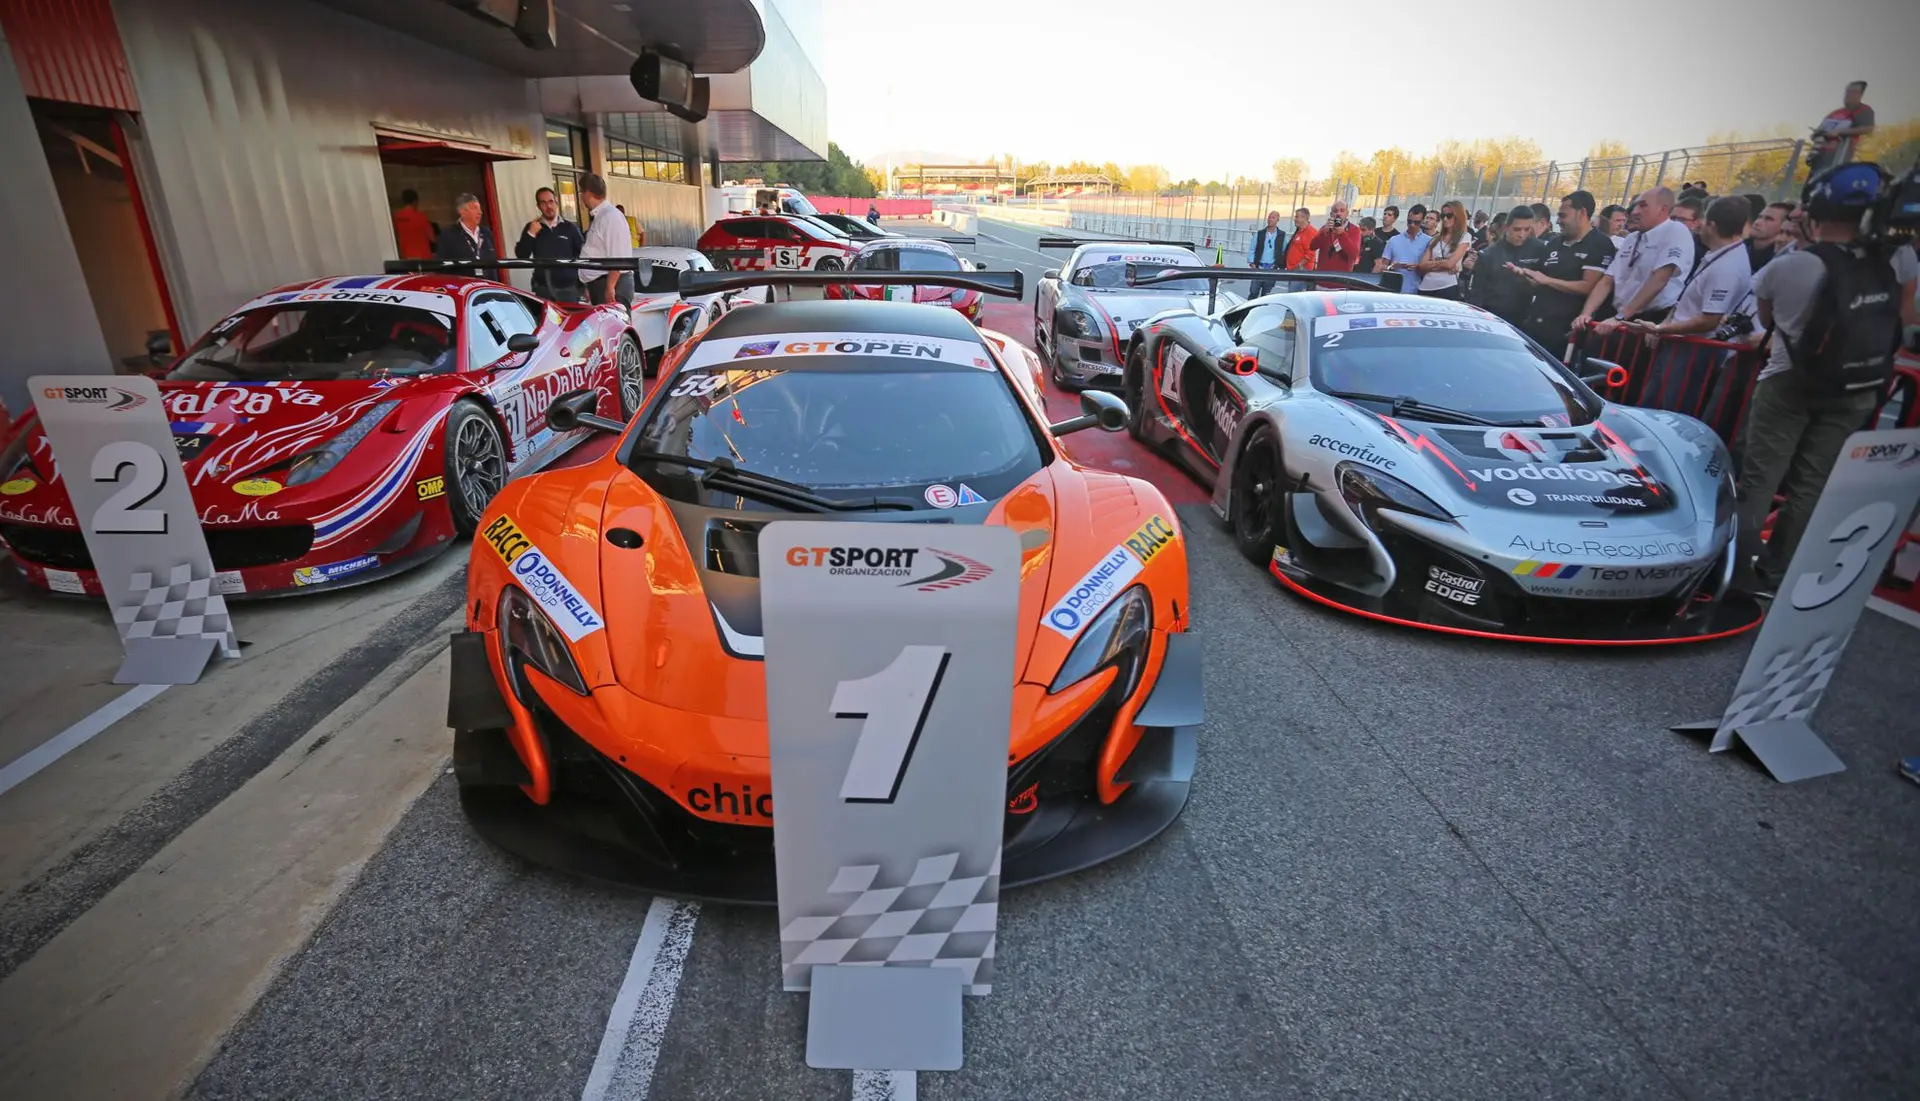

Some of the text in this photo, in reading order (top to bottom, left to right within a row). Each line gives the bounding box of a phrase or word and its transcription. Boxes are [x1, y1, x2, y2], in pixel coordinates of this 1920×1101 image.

[1384, 318, 1493, 333] GTOPEN
[784, 341, 942, 359] GTOPEN
[1322, 332, 1344, 348] 2
[1077, 361, 1109, 373] ERICSSON
[44, 387, 108, 399] GTSPORT
[670, 375, 724, 397] 59
[1309, 433, 1397, 471] accenture
[1468, 463, 1644, 487] vodafone
[90, 440, 169, 535] 2
[418, 480, 445, 498] OMP
[932, 488, 950, 504] E
[1544, 494, 1647, 508] TRANQUILIDADE
[484, 516, 530, 562] RACC
[1126, 516, 1174, 561] RACC
[1508, 535, 1695, 560] Auto-Recycling
[328, 555, 378, 575] MICHELIN
[786, 546, 919, 568] GTSPORT
[1790, 501, 1898, 612] 3
[1439, 571, 1479, 591] Castrol
[1588, 567, 1629, 580] Teo
[524, 574, 558, 607] GROUP
[1080, 581, 1114, 617] GROUP
[1424, 579, 1481, 606] EDGE
[828, 645, 953, 804] 1
